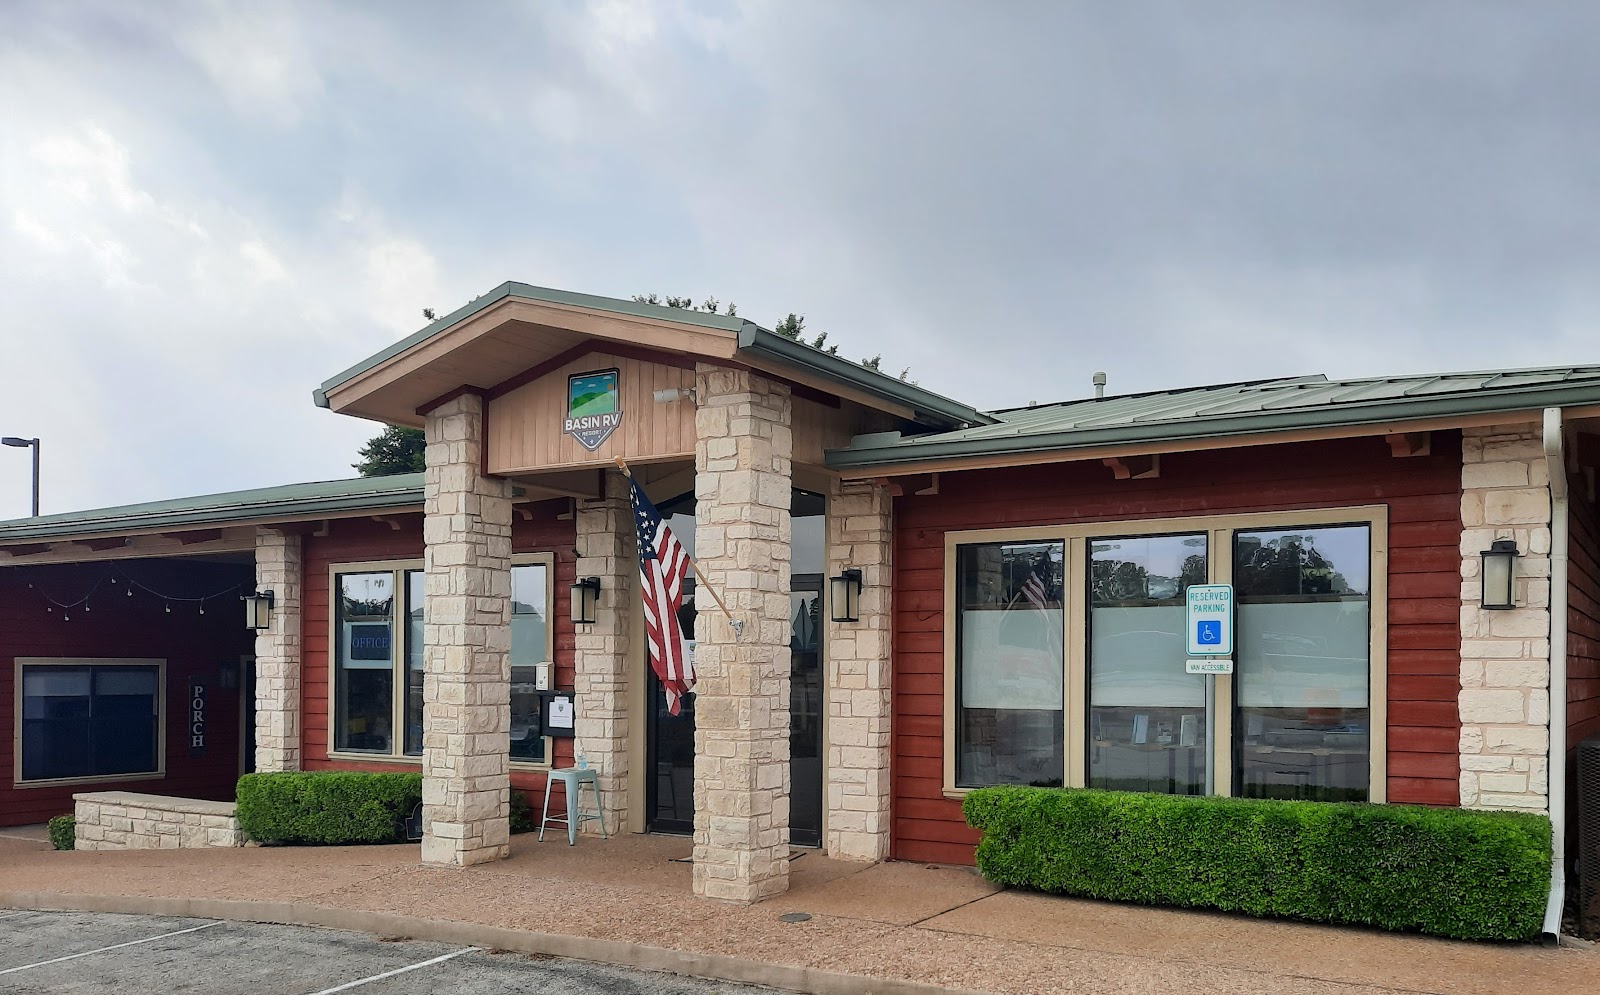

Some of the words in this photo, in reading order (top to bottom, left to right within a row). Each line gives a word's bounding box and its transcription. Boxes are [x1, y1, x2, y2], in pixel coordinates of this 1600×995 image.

[565, 415, 600, 431] BASIN
[602, 413, 620, 427] RV
[581, 429, 603, 437] RESORT
[1190, 591, 1229, 602] RESERVED
[1193, 603, 1226, 613] PARKING
[352, 637, 389, 649] OFFICE
[1201, 663, 1230, 672] ACCESSIBLE
[191, 685, 205, 748] PORCH
